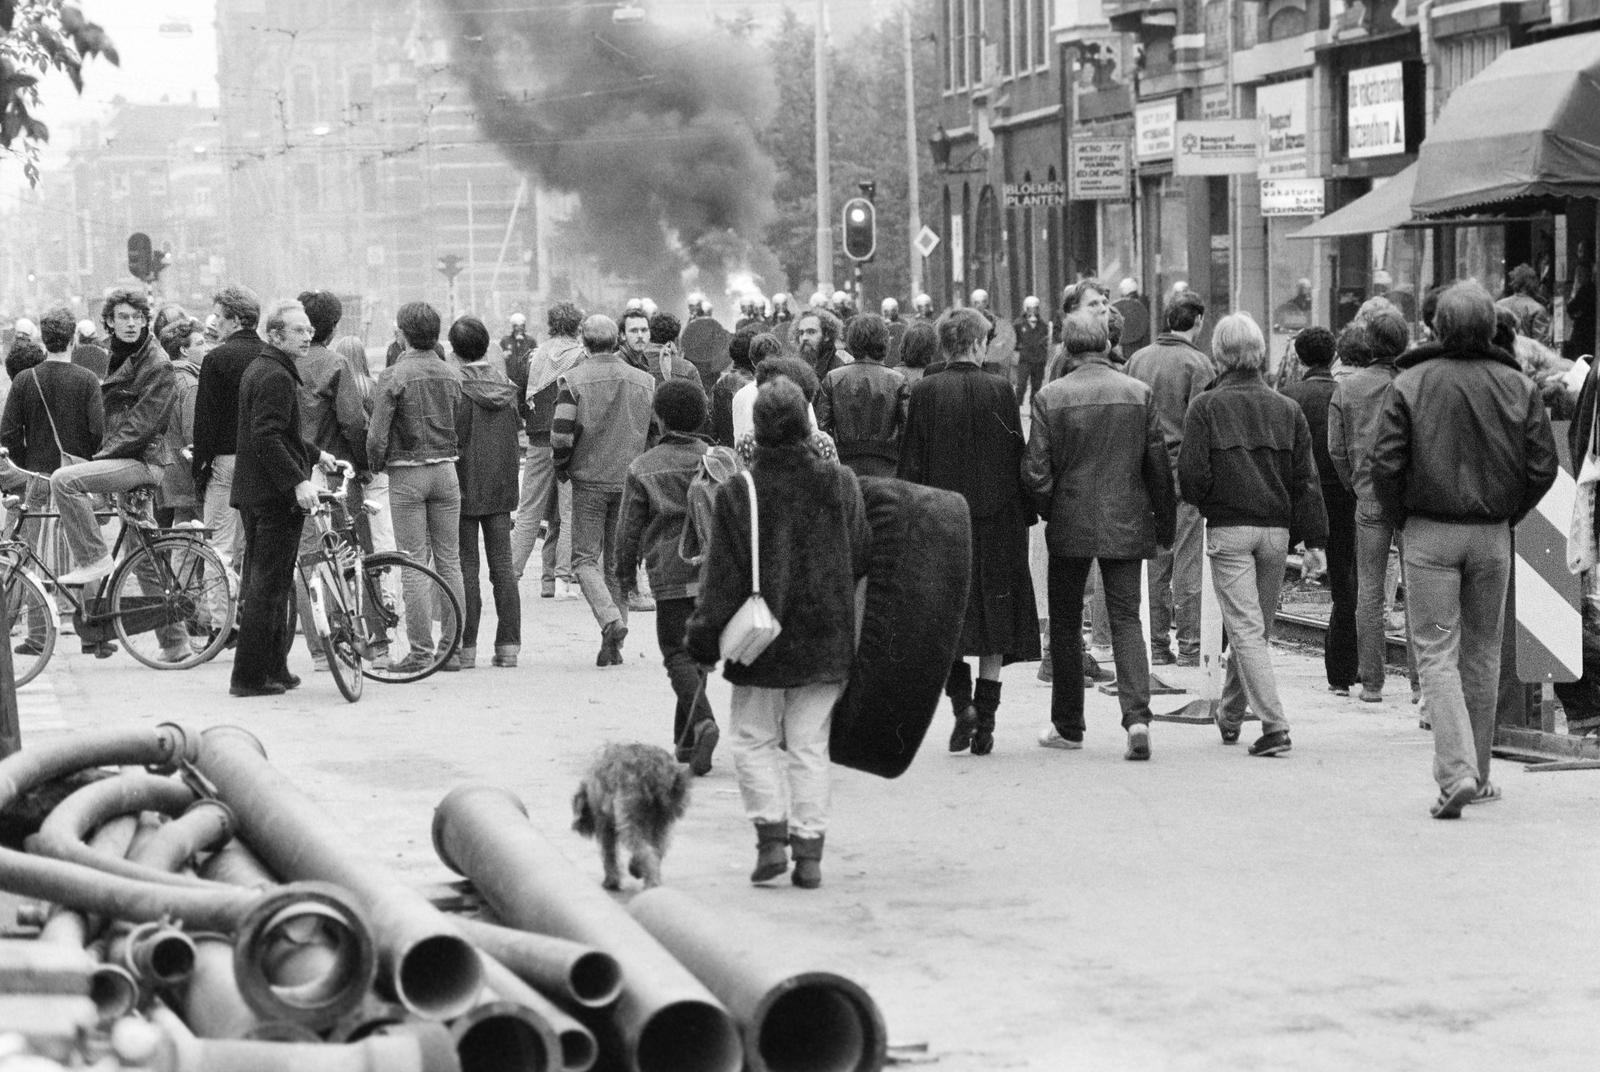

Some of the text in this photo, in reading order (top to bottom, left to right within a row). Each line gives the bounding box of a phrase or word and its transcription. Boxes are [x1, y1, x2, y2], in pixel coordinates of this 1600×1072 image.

[1006, 182, 1065, 195] BLOEMEN
[1263, 181, 1275, 189] de
[1007, 195, 1064, 206] PLANTEN
[1296, 196, 1323, 205] bank
